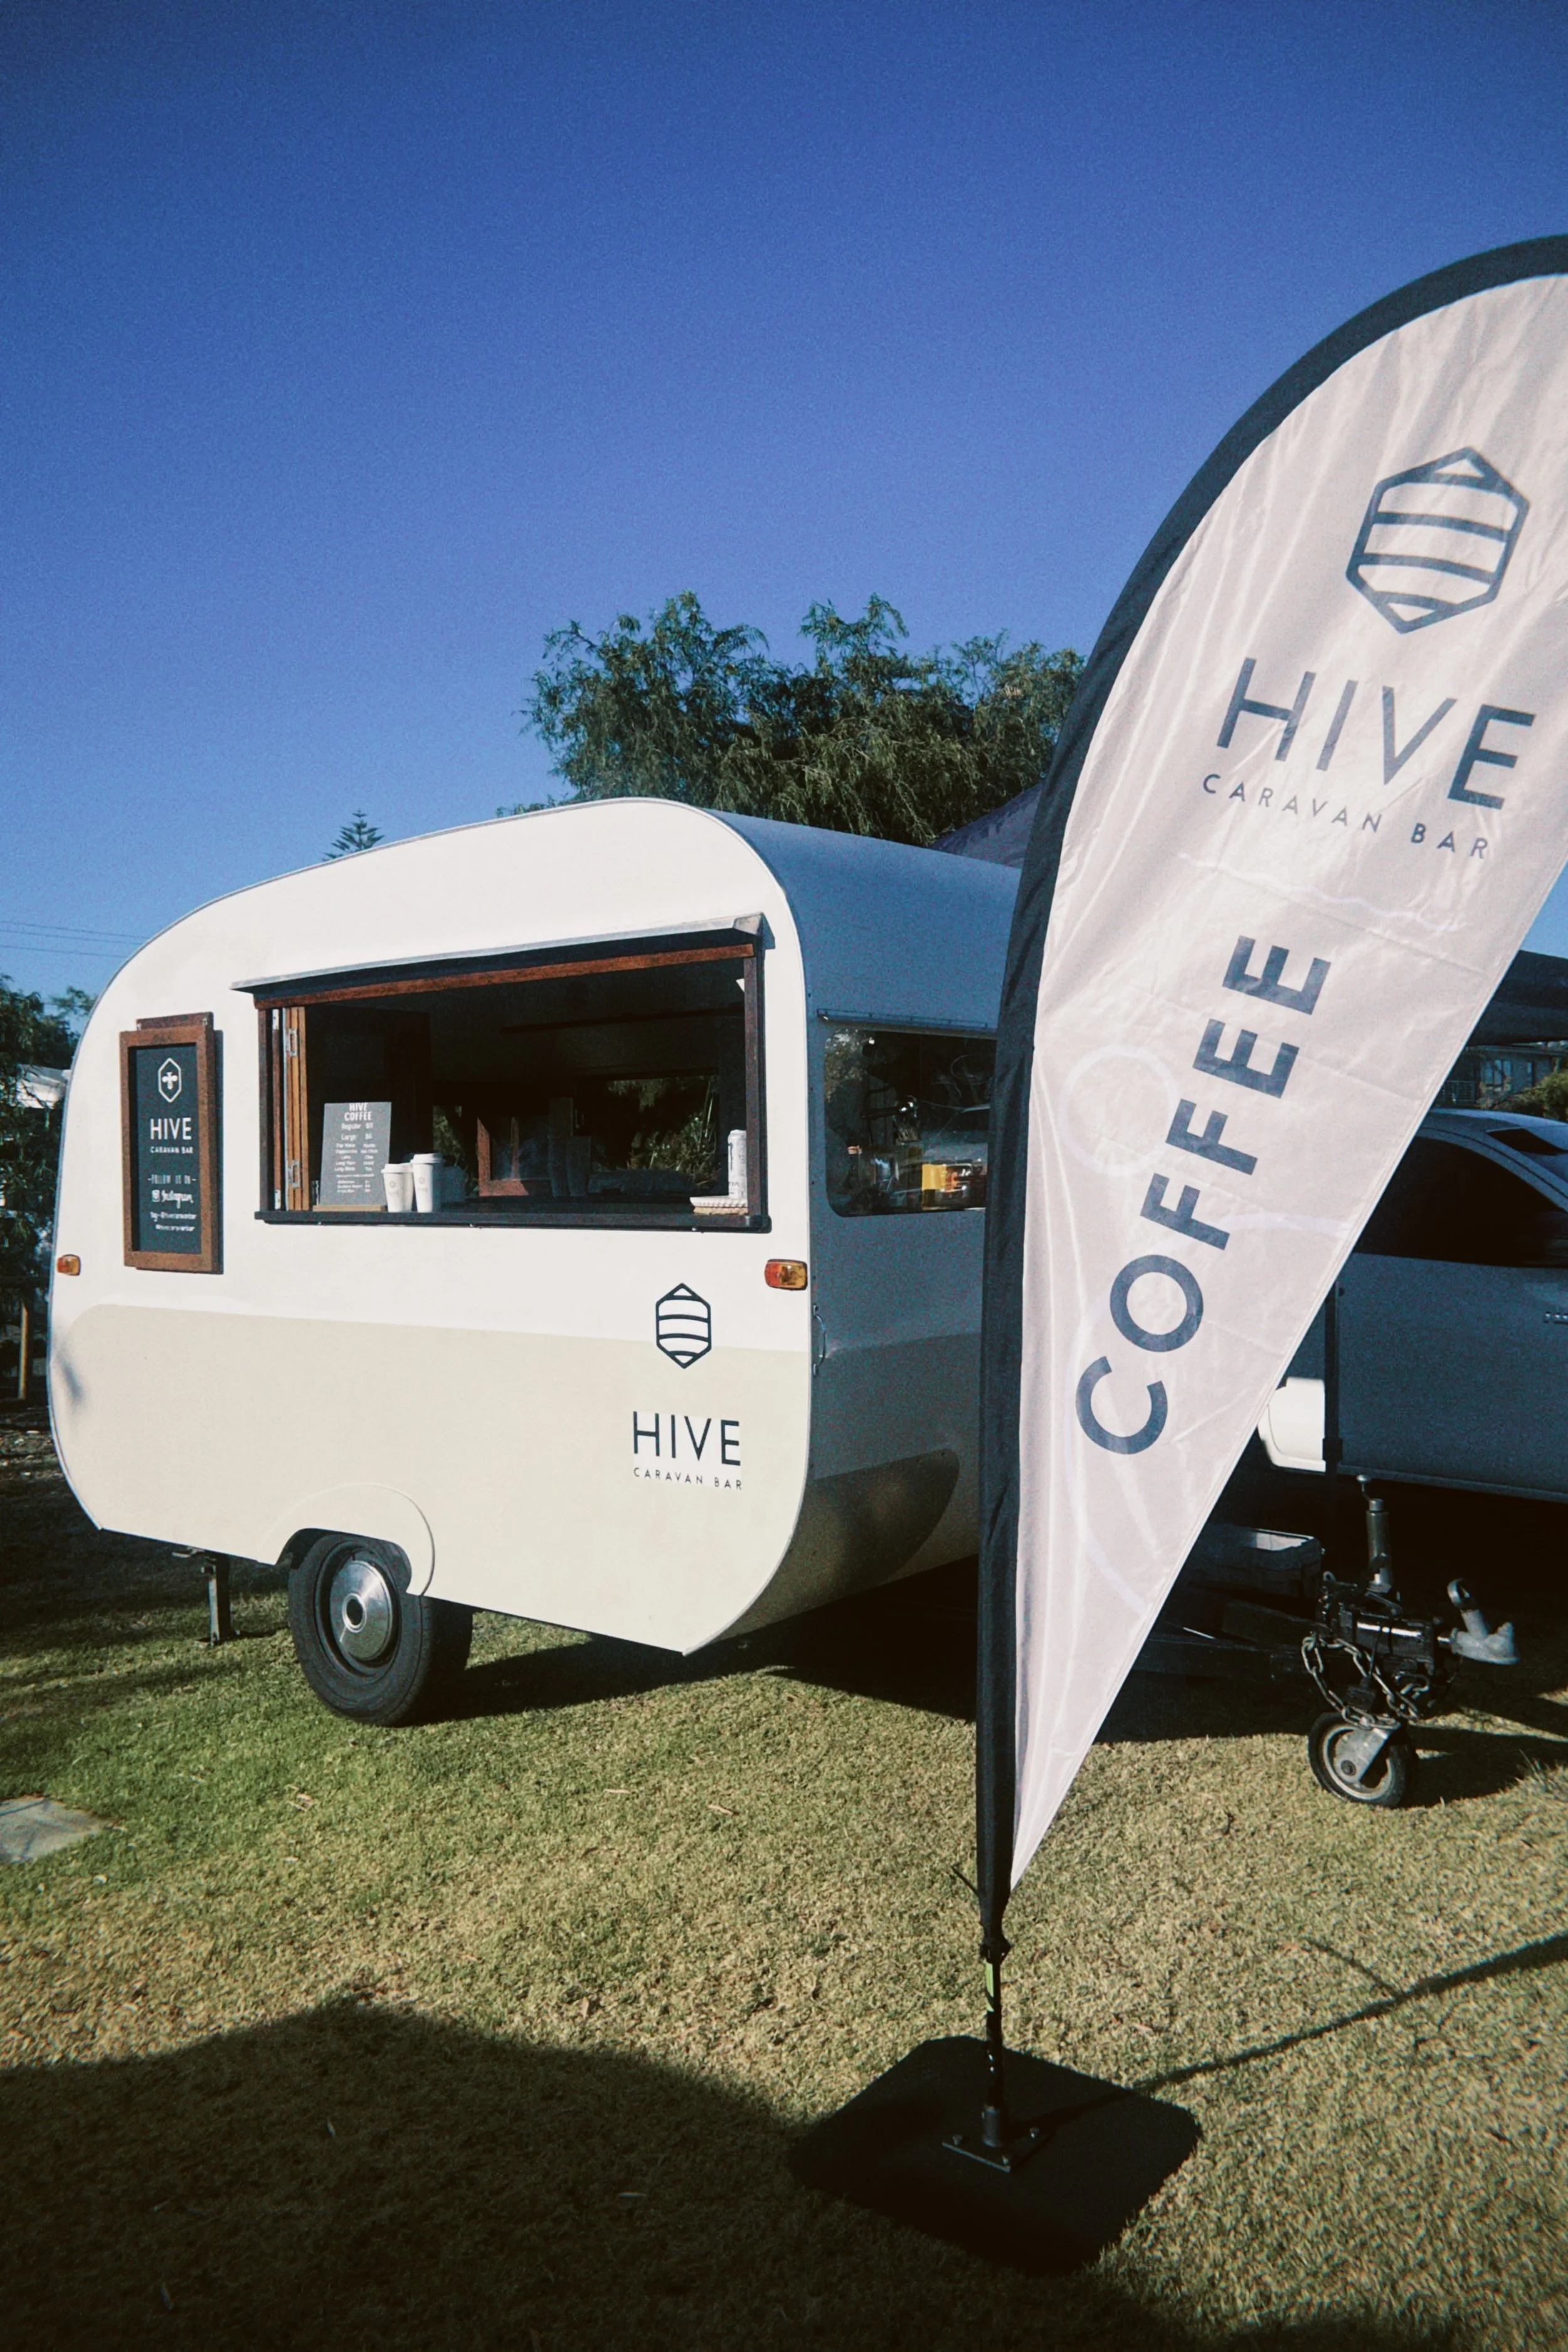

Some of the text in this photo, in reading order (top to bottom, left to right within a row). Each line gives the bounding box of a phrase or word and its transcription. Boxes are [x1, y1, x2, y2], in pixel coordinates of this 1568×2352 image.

[1217, 657, 1537, 810] HIVE
[1202, 773, 1489, 859] CARAVAN BAR
[344, 1111, 372, 1121] COFFEE
[349, 1103, 368, 1111] HIVE
[150, 1117, 192, 1140] HIVE
[150, 1146, 194, 1154] CARAVAN BAR
[1076, 935, 1331, 1455] COFFEE
[633, 1411, 741, 1466] HIVE
[633, 1467, 743, 1490] CARAVAN BAR
